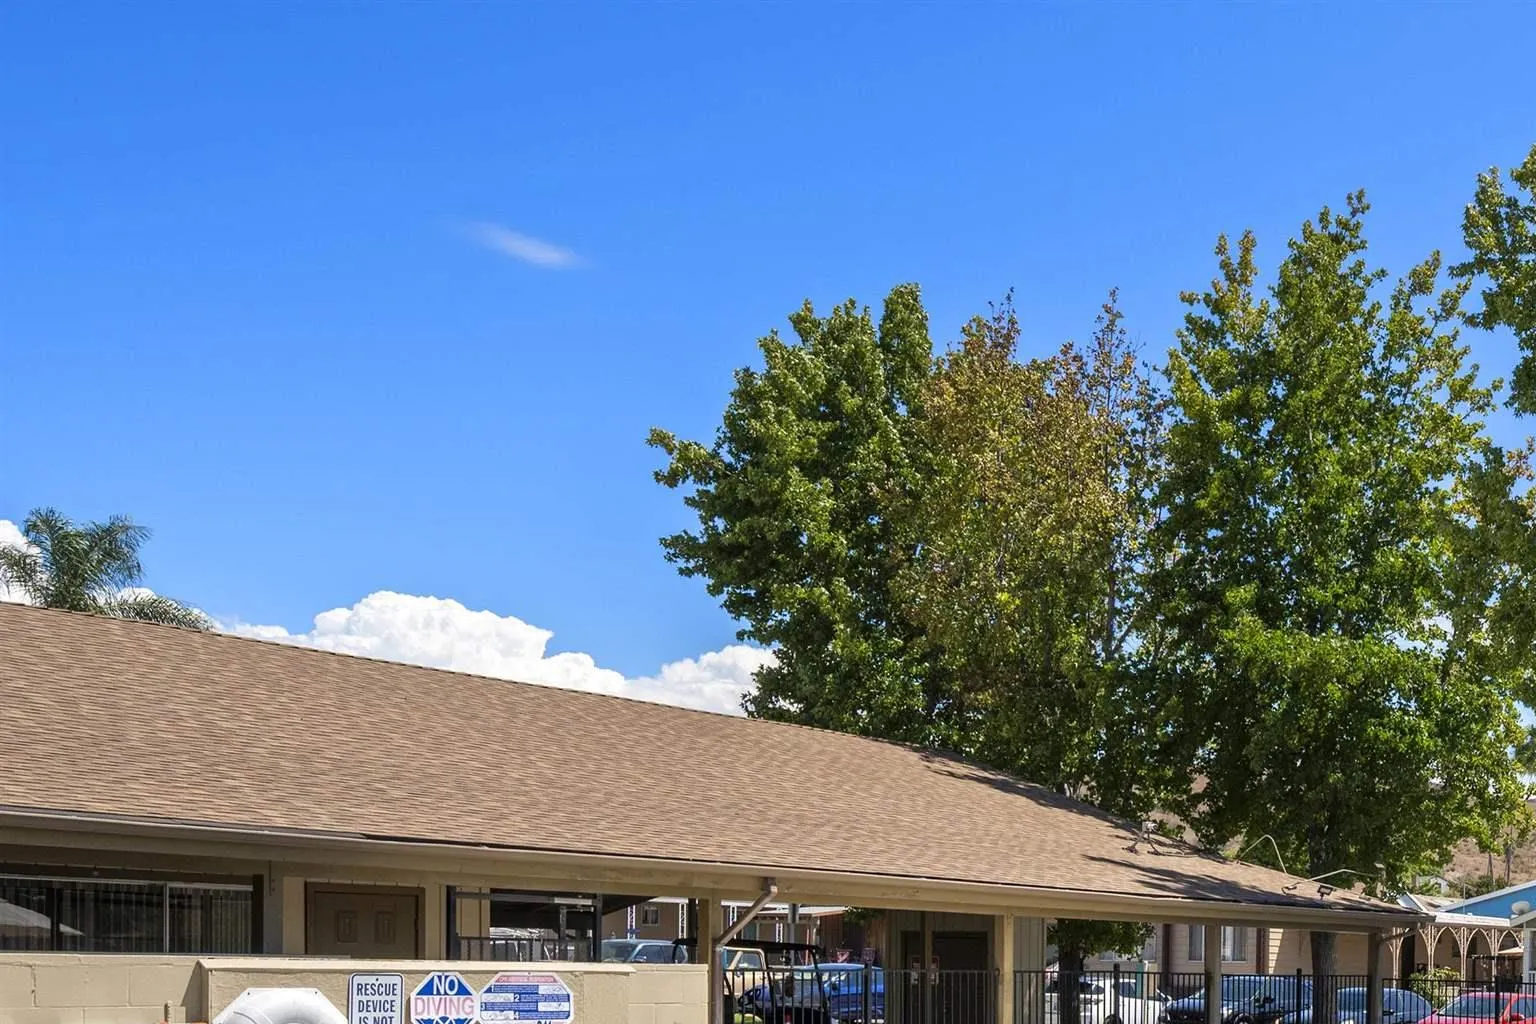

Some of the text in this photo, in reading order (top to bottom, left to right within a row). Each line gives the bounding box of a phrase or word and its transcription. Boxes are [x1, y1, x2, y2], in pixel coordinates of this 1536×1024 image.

[356, 983, 398, 996] RESCUE
[433, 975, 459, 995] NO
[358, 1000, 396, 1013] DEVICE
[415, 997, 474, 1015] DIVING
